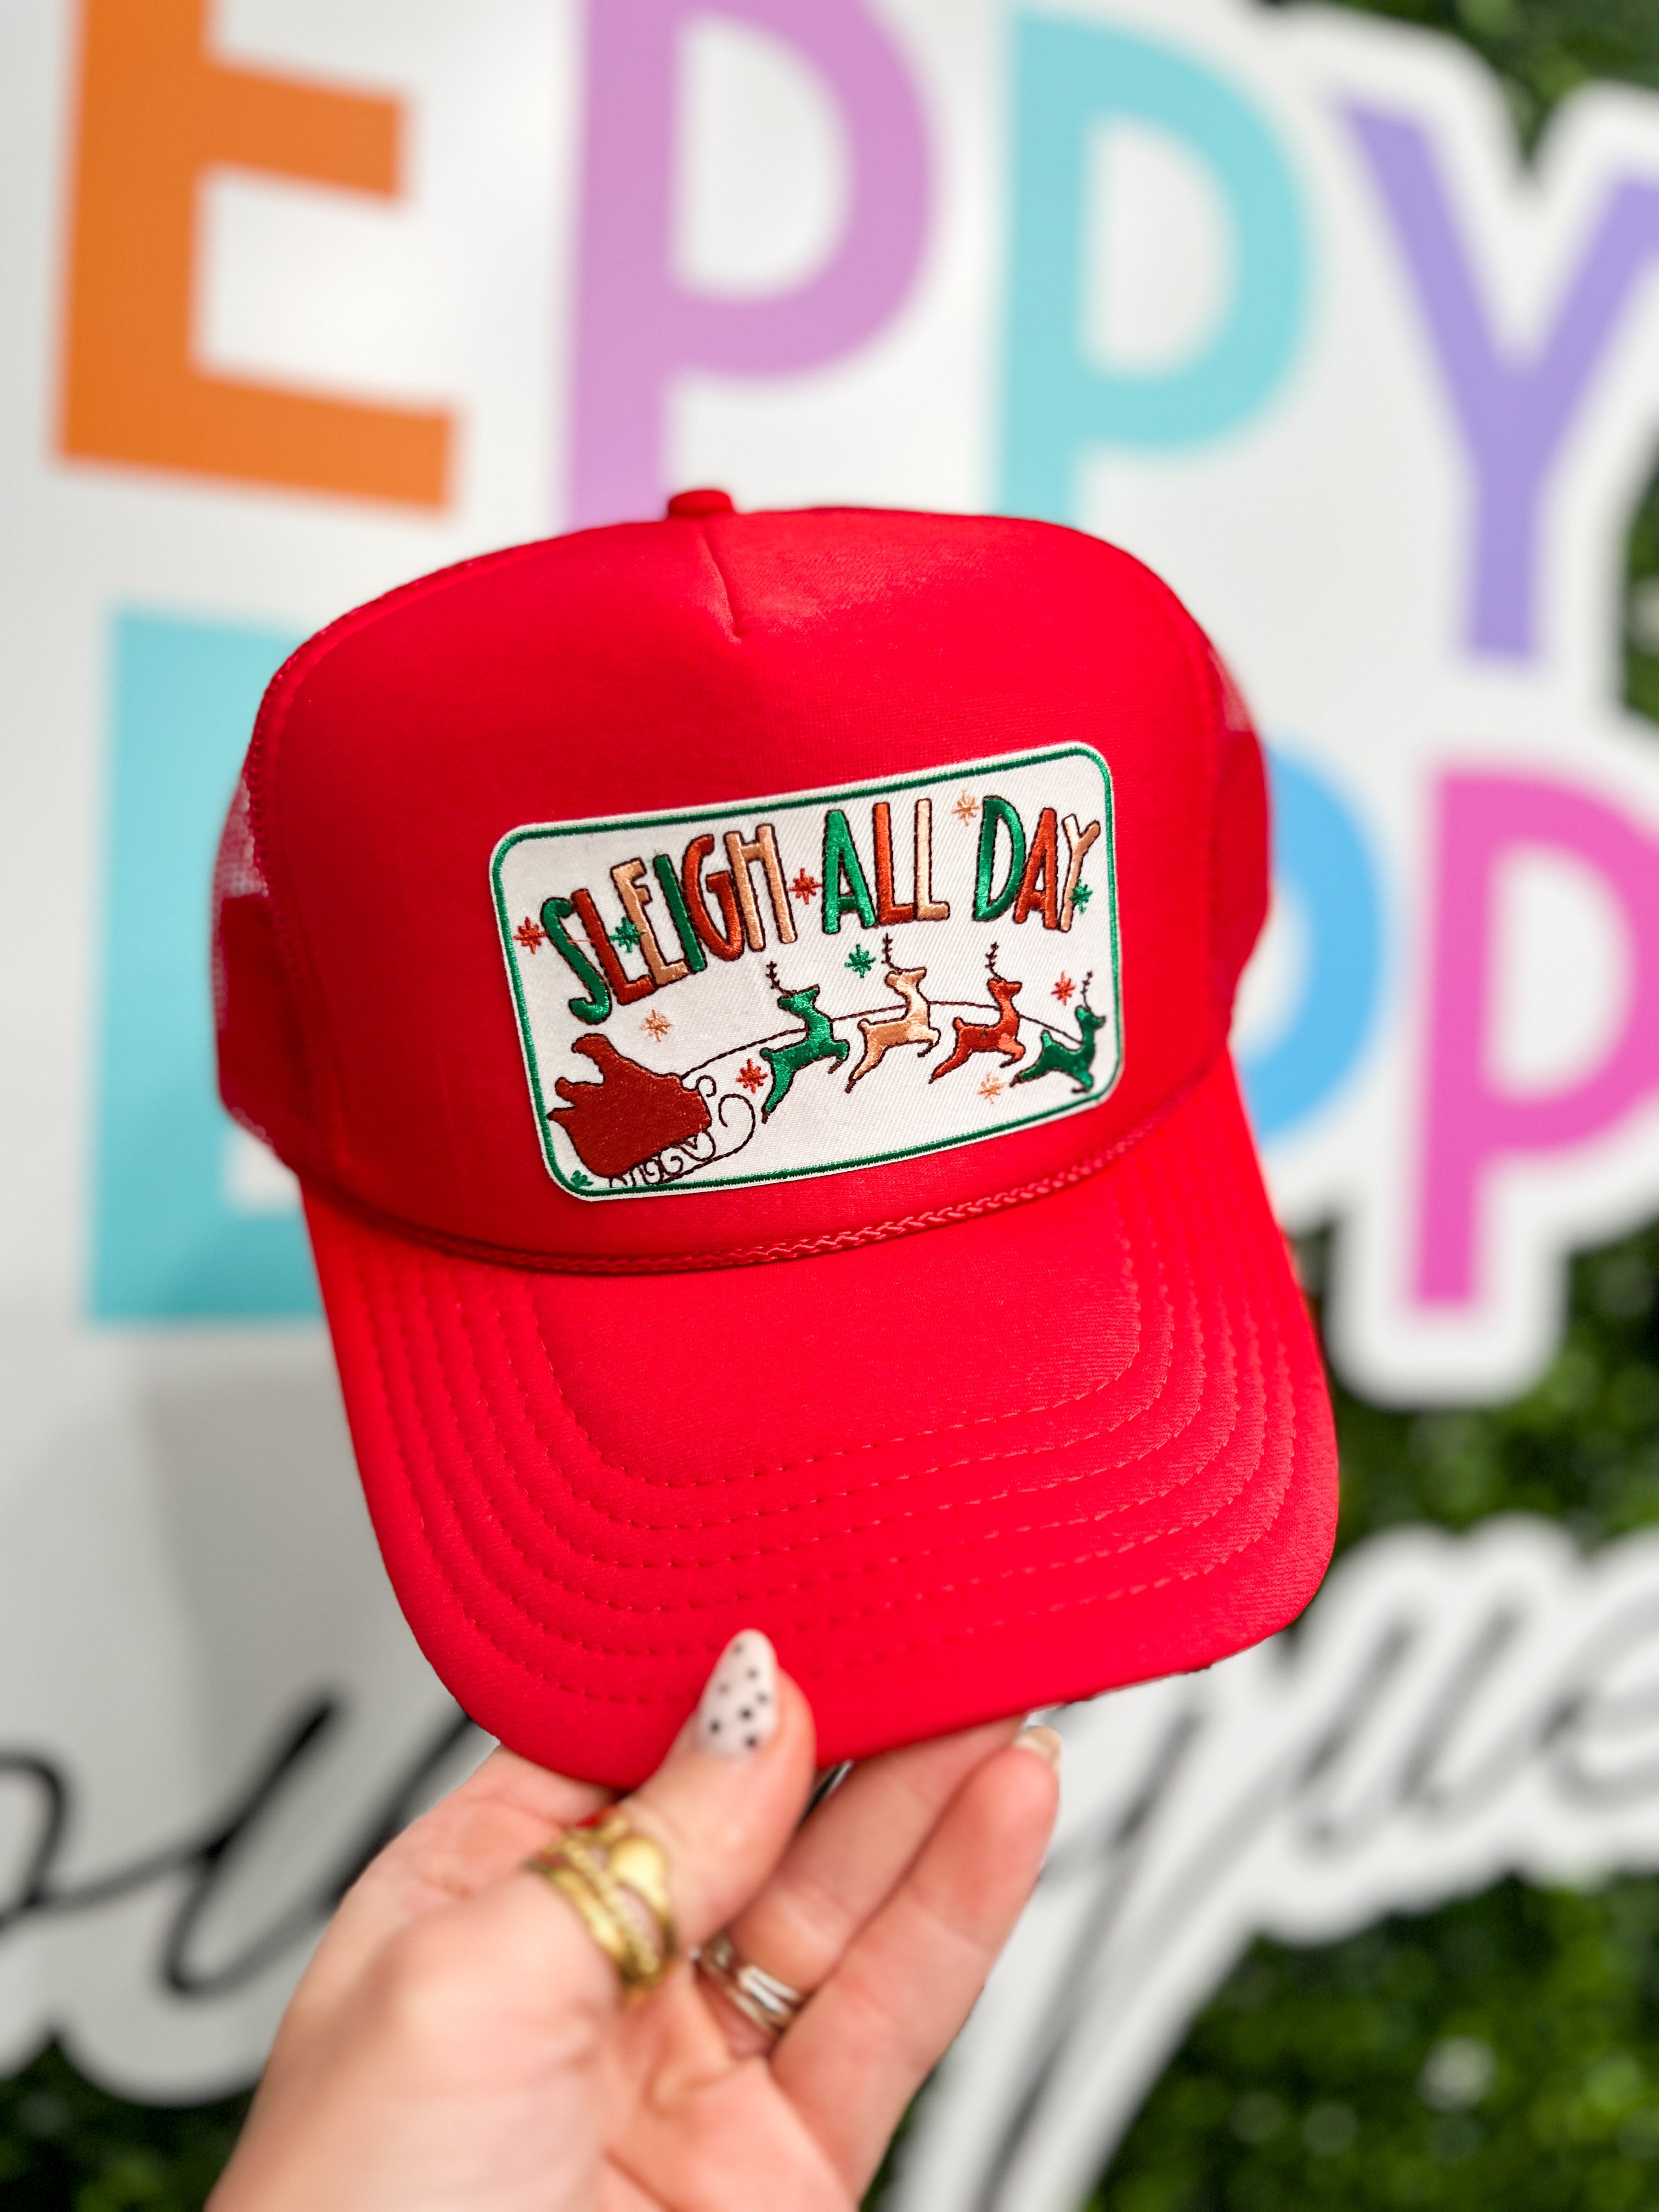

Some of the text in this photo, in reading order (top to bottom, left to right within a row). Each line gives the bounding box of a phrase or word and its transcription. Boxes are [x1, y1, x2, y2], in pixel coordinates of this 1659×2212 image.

[541, 795, 1101, 1025] SLEIGH ALL DAY
